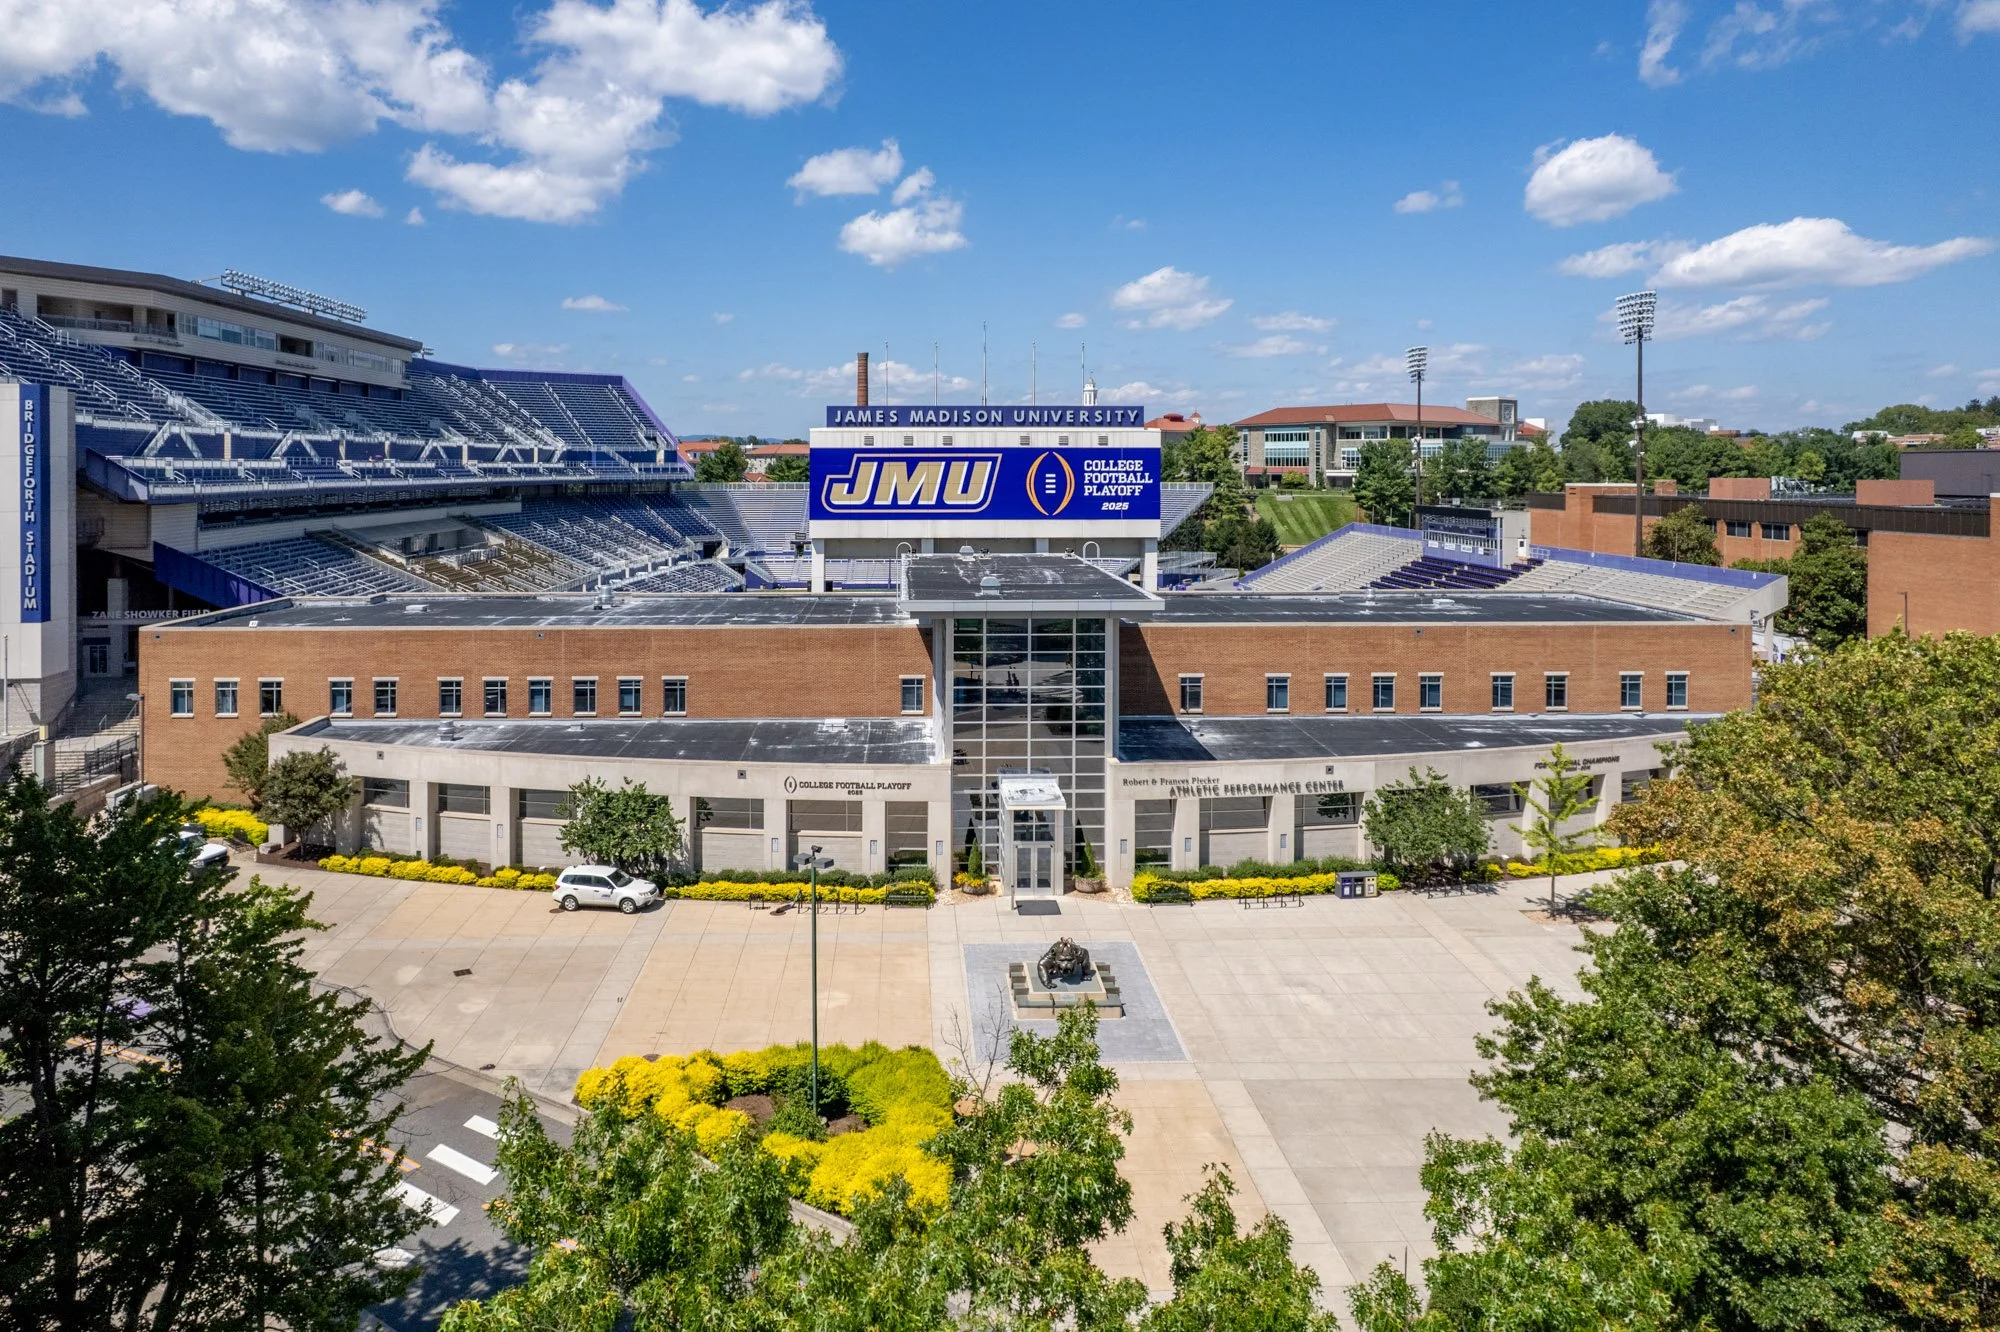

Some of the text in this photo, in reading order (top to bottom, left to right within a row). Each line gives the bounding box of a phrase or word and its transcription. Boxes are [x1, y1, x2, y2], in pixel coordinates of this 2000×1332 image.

[835, 410, 1138, 423] JAMES MADISON UNIVERSITY
[1083, 459, 1144, 472] COLLEGE
[828, 460, 993, 505] JMU
[1083, 472, 1154, 484] FOOTBALL
[1083, 485, 1144, 497] PLAYOFF
[24, 400, 37, 609] BRIDGEFORTH STADIUM
[1101, 502, 1130, 511] 2025
[91, 611, 121, 619] ZANE
[124, 610, 179, 619] SHOWKER
[799, 781, 834, 789] COLLEGE
[877, 782, 912, 790] PLAYOFF
[1122, 776, 1221, 786] Robert & Frances Plecker
[1169, 779, 1345, 797] ATHLETIC PERFORMANCE CENTER
